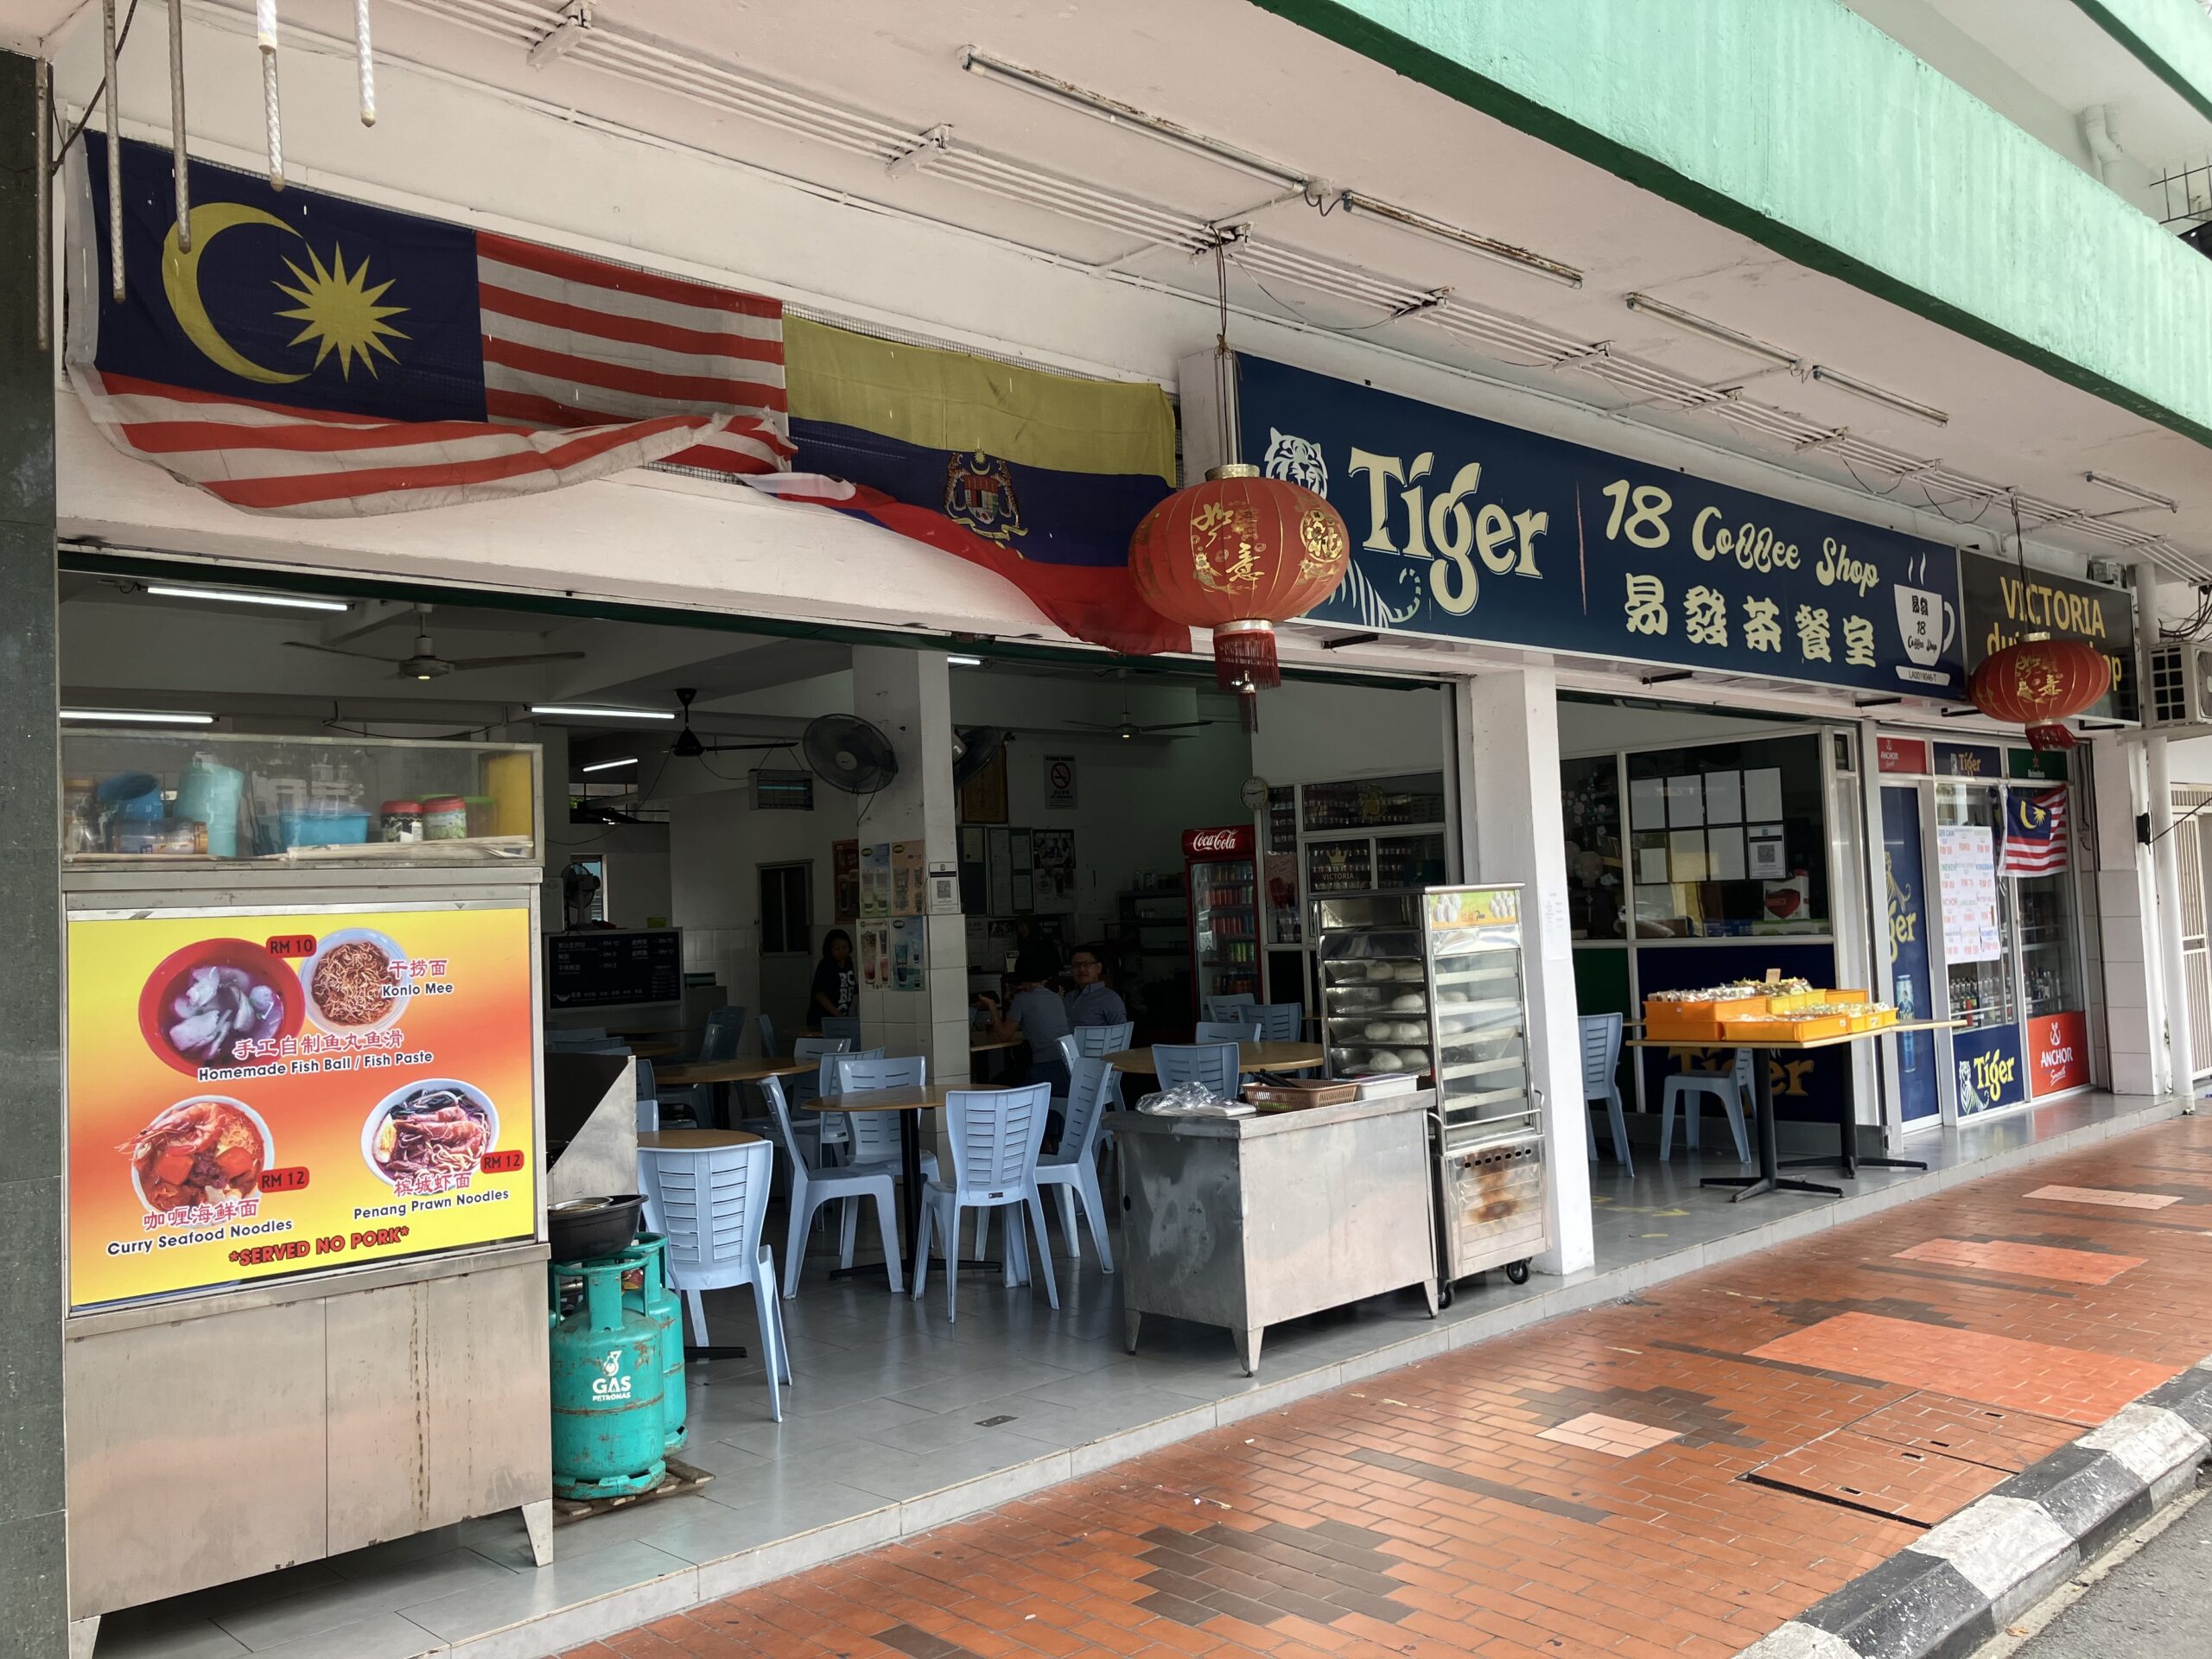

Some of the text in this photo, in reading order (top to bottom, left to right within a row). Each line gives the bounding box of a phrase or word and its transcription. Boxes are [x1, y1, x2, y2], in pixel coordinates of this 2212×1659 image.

[1348, 447, 1549, 616] Tiger
[1602, 479, 1880, 597] 18 Coffee Shop
[1999, 575, 2107, 639] VICTORIA
[1958, 752, 1982, 777] Tiger
[270, 938, 314, 954] RM 10
[388, 959, 448, 979] 干捞面
[383, 982, 454, 998] Konlo Mee
[232, 1030, 404, 1060] 手工自制鱼丸鱼滑
[2040, 1046, 2074, 1069] ANCHOR
[198, 1063, 287, 1082] Homemade
[291, 1059, 319, 1074] Fish
[324, 1056, 351, 1071] Ball
[364, 1054, 391, 1068] Fish
[395, 1051, 433, 1065] Paste
[1974, 1048, 2015, 1102] Tiger
[484, 1154, 521, 1169] RM 12
[262, 1172, 305, 1188] RM 12
[394, 1172, 473, 1197] 槟城虾面
[143, 1198, 260, 1230] 咖喱海鲜面
[354, 1189, 509, 1220] Penang Prawn Noodles
[107, 1219, 293, 1255] Curry Seafood Noodles
[315, 1235, 346, 1255] NO
[592, 1375, 632, 1395] GAS
[592, 1392, 632, 1402] PETRONAS
